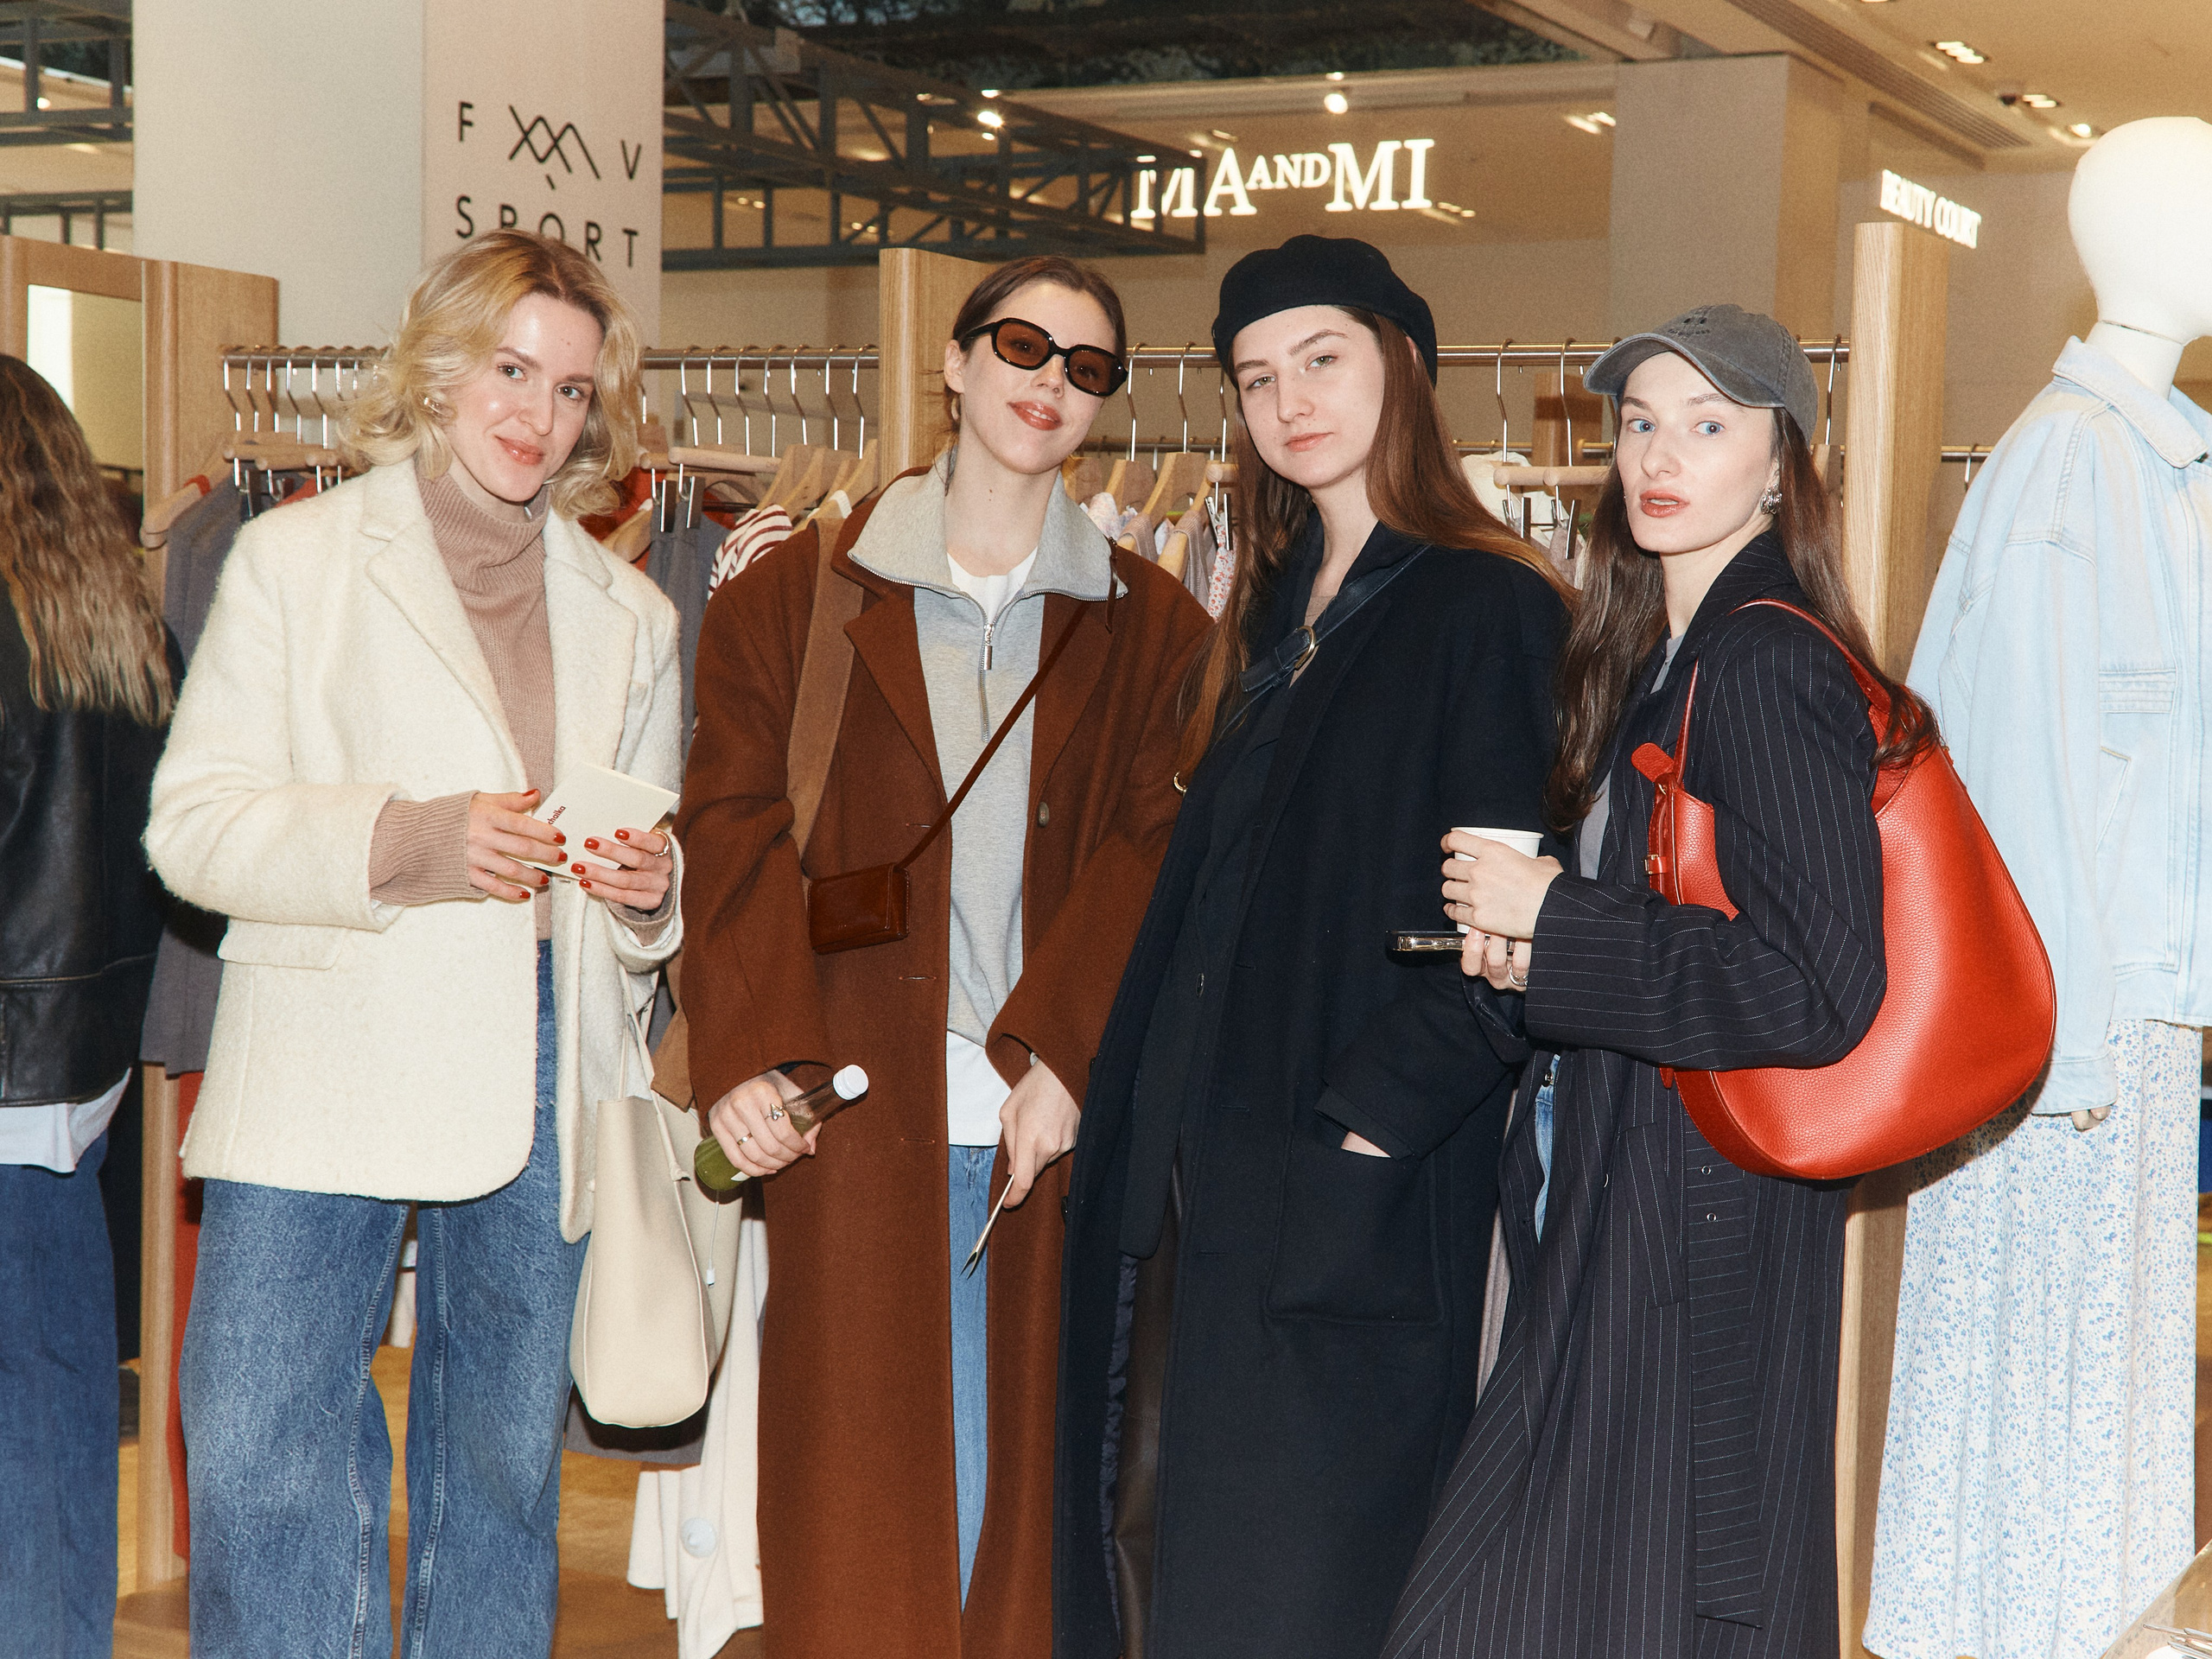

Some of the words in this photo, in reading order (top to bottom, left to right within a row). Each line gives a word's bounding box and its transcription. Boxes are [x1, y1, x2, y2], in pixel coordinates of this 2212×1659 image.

[455, 194, 639, 268] SPORT
[1880, 169, 1936, 228] BEAUTY
[1934, 196, 1982, 249] COURT
